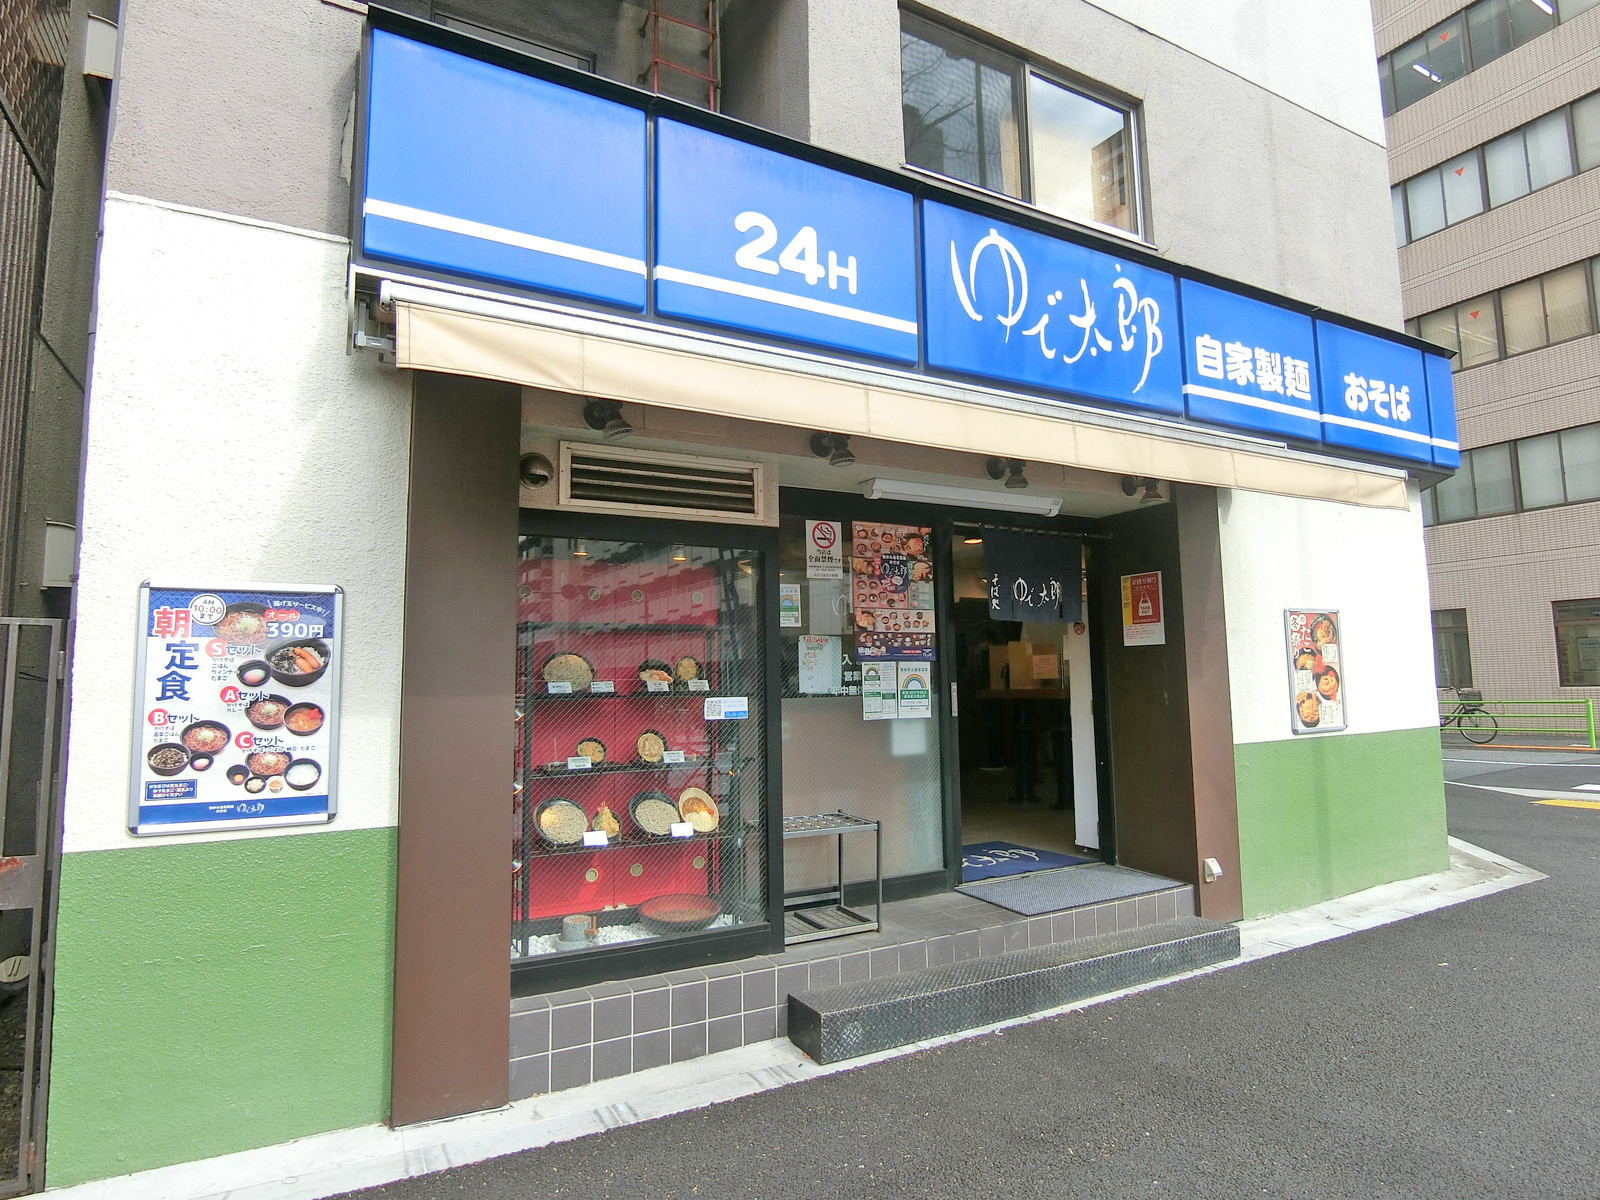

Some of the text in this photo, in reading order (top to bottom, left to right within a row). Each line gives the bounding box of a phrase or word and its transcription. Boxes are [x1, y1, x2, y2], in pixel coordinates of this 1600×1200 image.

[734, 211, 857, 295] 24H
[950, 228, 1162, 394] ゆで太郎
[1195, 333, 1311, 401] 自家製麺
[1344, 372, 1411, 422] おそば
[193, 605, 223, 614] 10:00
[1012, 577, 1061, 610] ゆで太郎
[267, 611, 298, 620] オール
[267, 622, 325, 638] 390円
